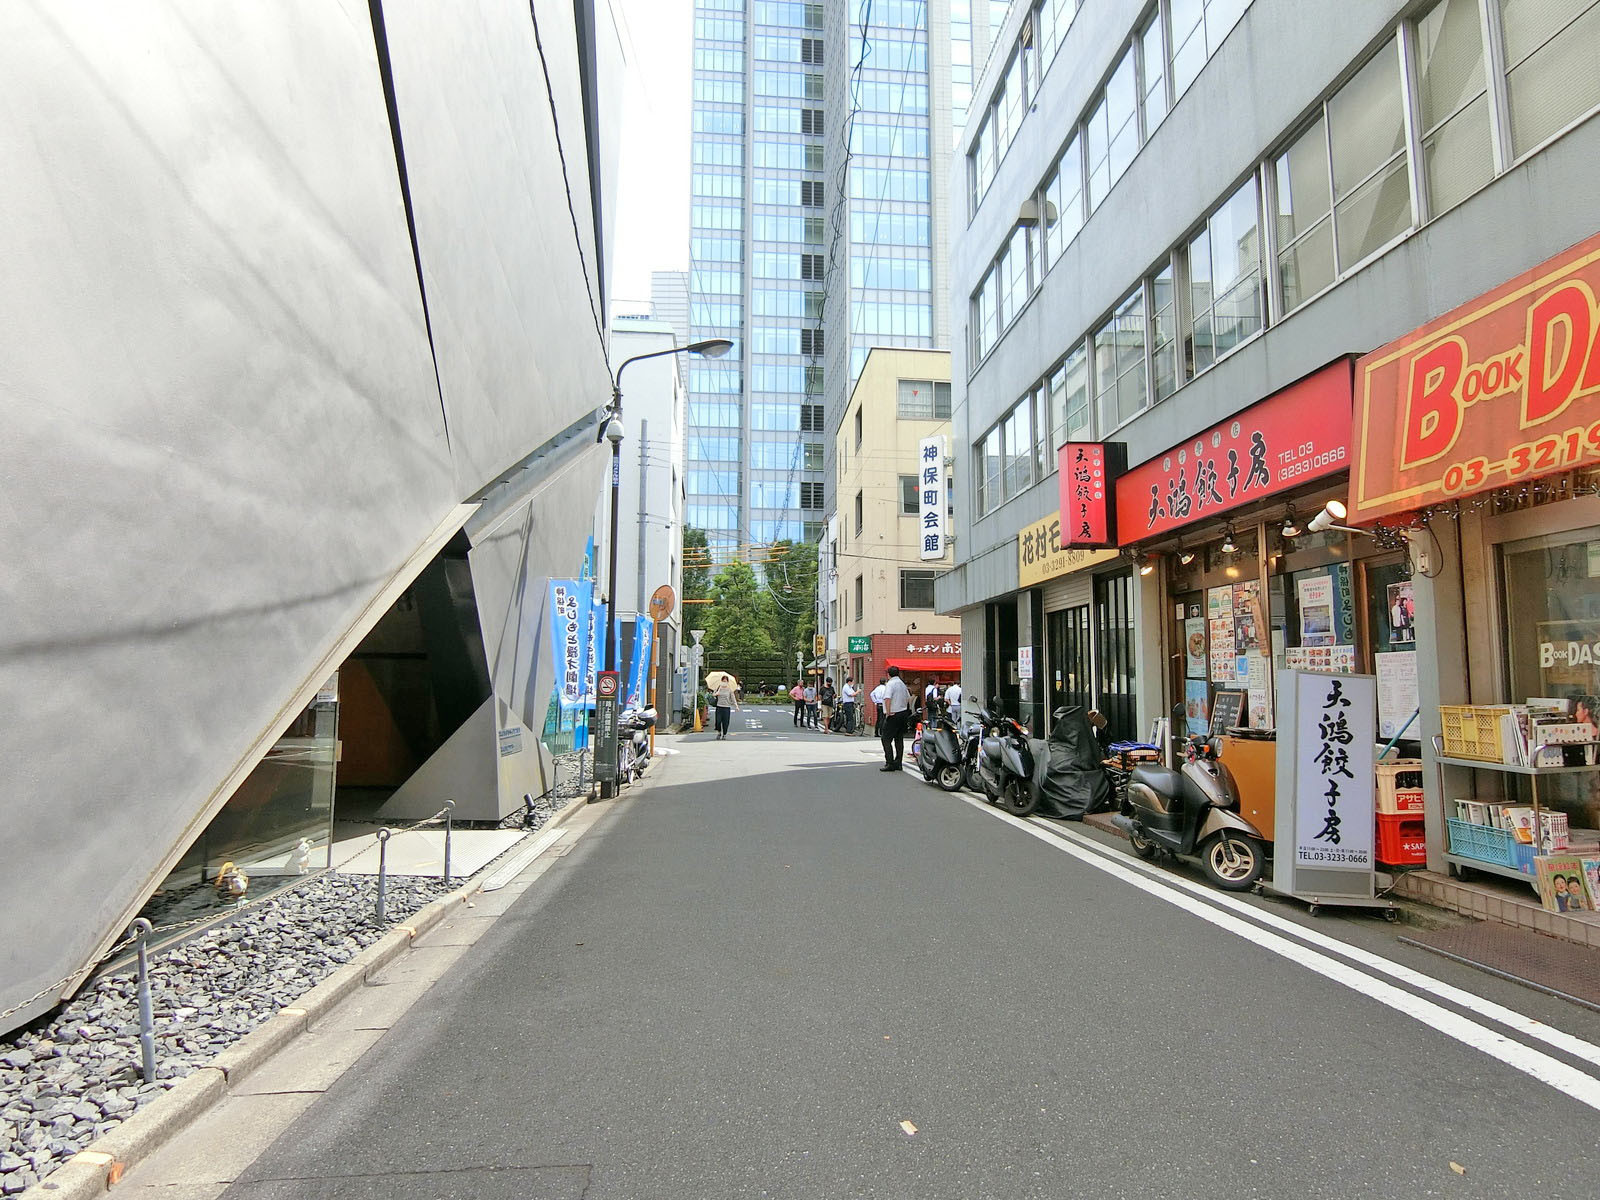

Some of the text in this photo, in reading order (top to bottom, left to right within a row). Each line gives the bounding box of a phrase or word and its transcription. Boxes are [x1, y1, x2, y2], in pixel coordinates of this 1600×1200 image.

[1402, 336, 1525, 469] BOOK
[1148, 431, 1270, 529] 天鴻餃子房
[1277, 446, 1346, 482] (3233)0666
[1278, 441, 1314, 466] TEL 03
[923, 444, 939, 552] 神保町会館
[1074, 448, 1092, 538] 天鴻餃子房
[1022, 520, 1060, 567] 花村モ
[906, 643, 940, 654] キッチン
[1313, 680, 1354, 845] 天鴻餃子房
[1299, 851, 1368, 864] TEL.03-3233-0666
